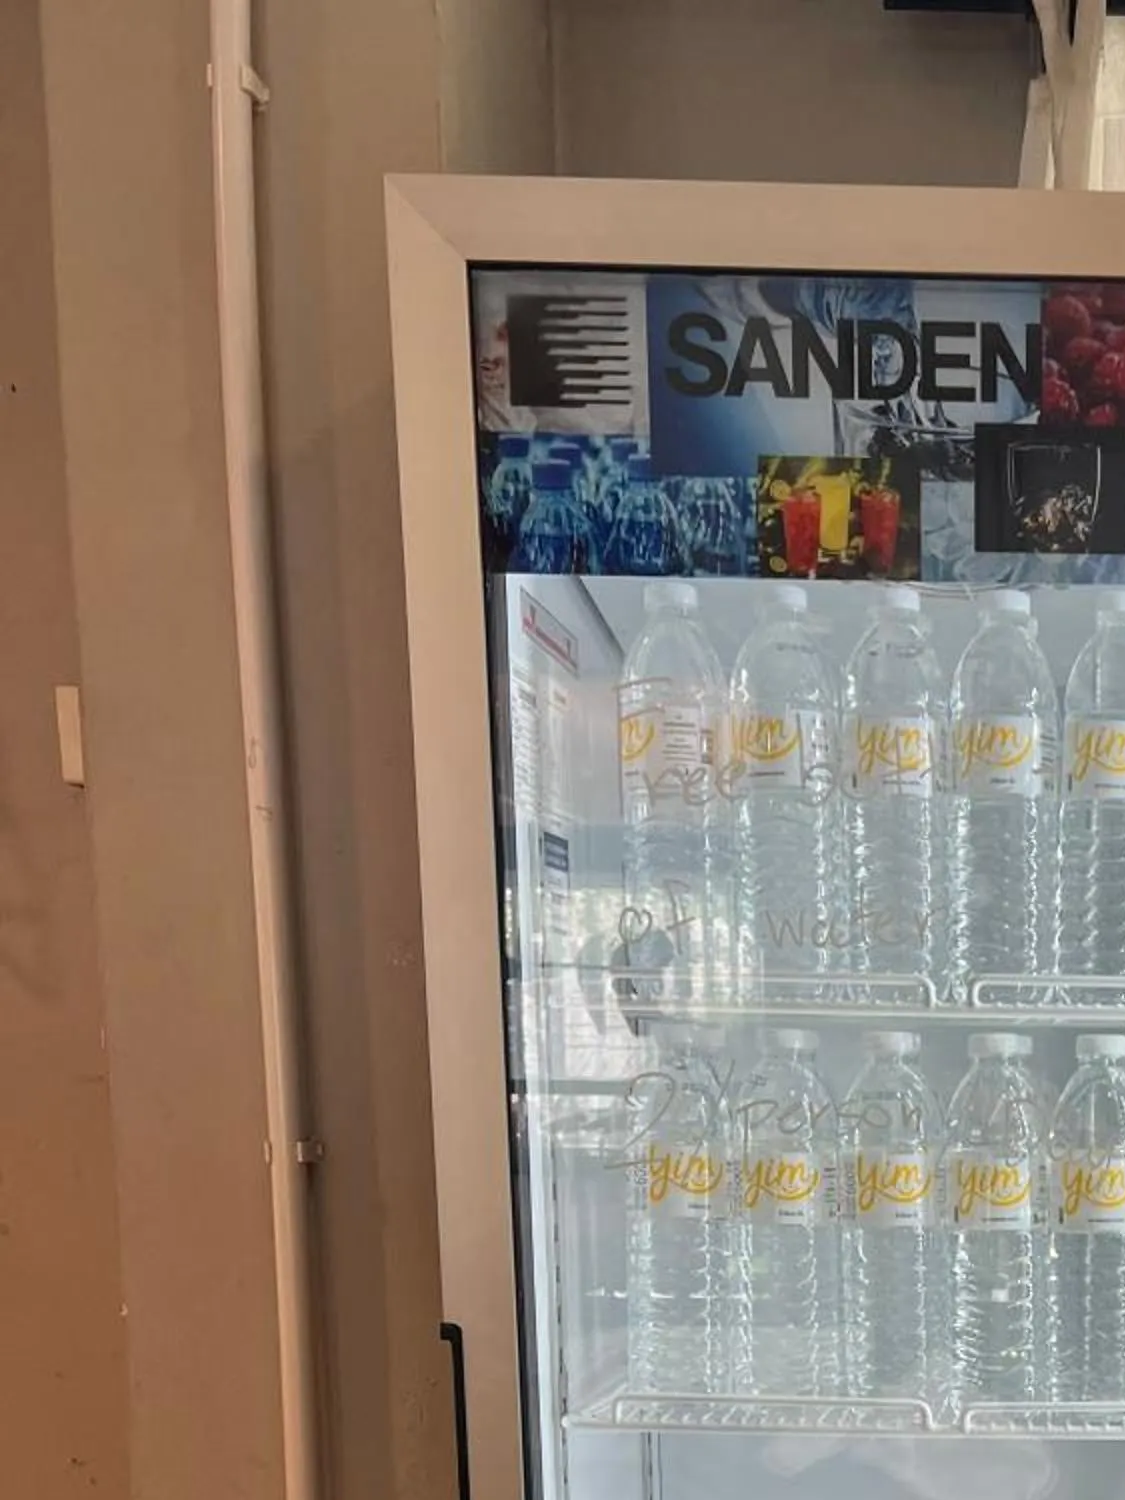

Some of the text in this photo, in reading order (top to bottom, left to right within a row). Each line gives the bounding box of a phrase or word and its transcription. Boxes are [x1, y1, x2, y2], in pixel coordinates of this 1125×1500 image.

[663, 311, 1041, 404] SANDEN
[955, 716, 1032, 781] yim
[742, 1151, 822, 1209] yim
[857, 1150, 932, 1211] yim
[957, 1157, 1032, 1216] yim
